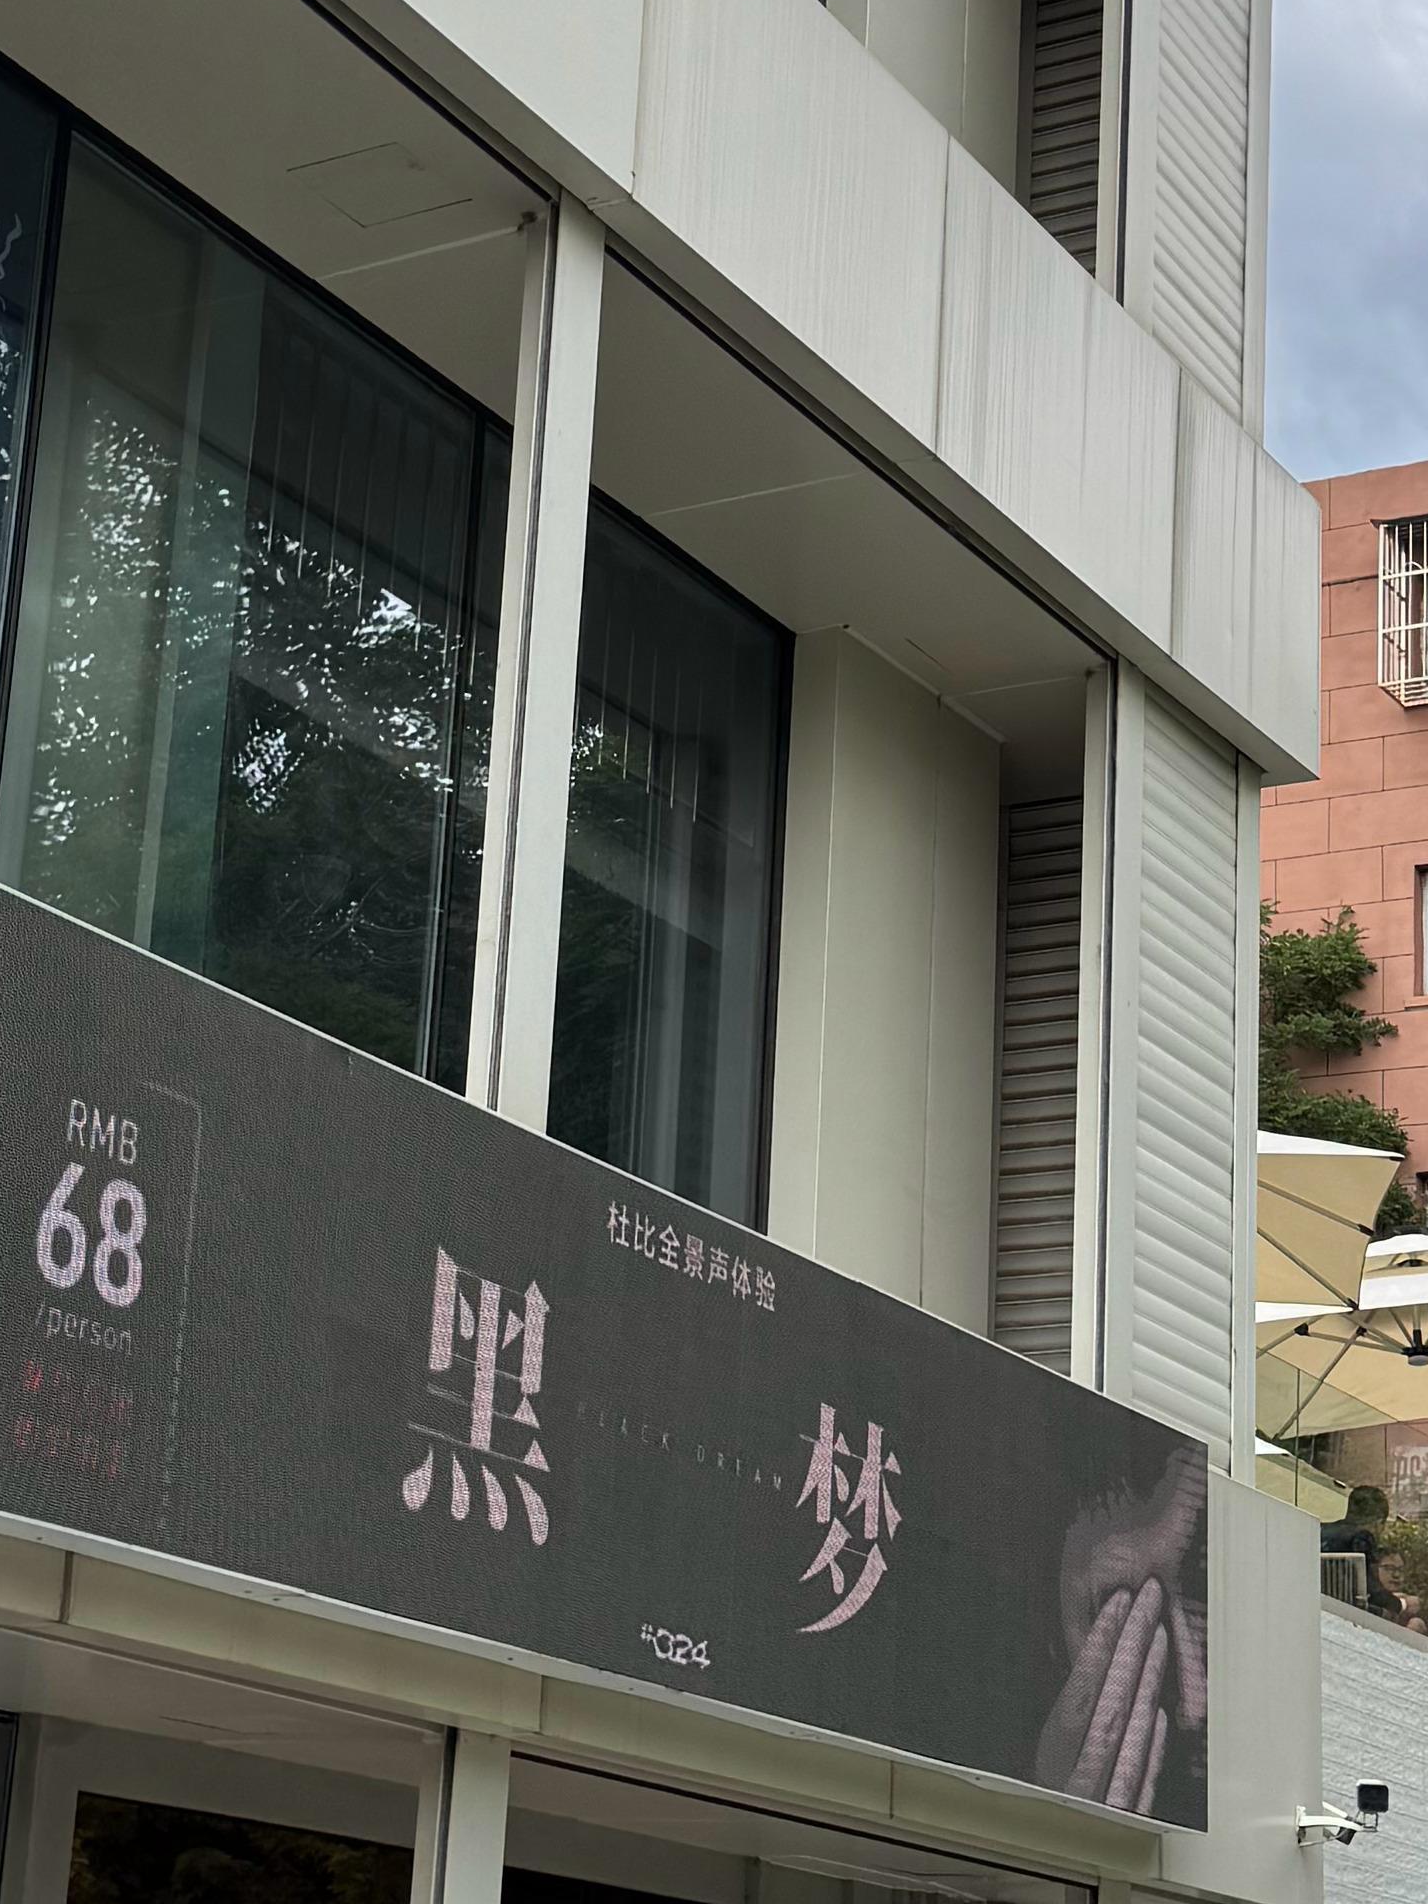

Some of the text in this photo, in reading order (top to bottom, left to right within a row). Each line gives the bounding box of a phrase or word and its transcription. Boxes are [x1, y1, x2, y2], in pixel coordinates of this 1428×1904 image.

[65, 1099, 139, 1166] RMB
[35, 1160, 148, 1309] 68
[606, 1199, 778, 1313] 杜比全景声体验
[402, 1246, 551, 1546] 黑
[795, 1402, 903, 1636] 梦
